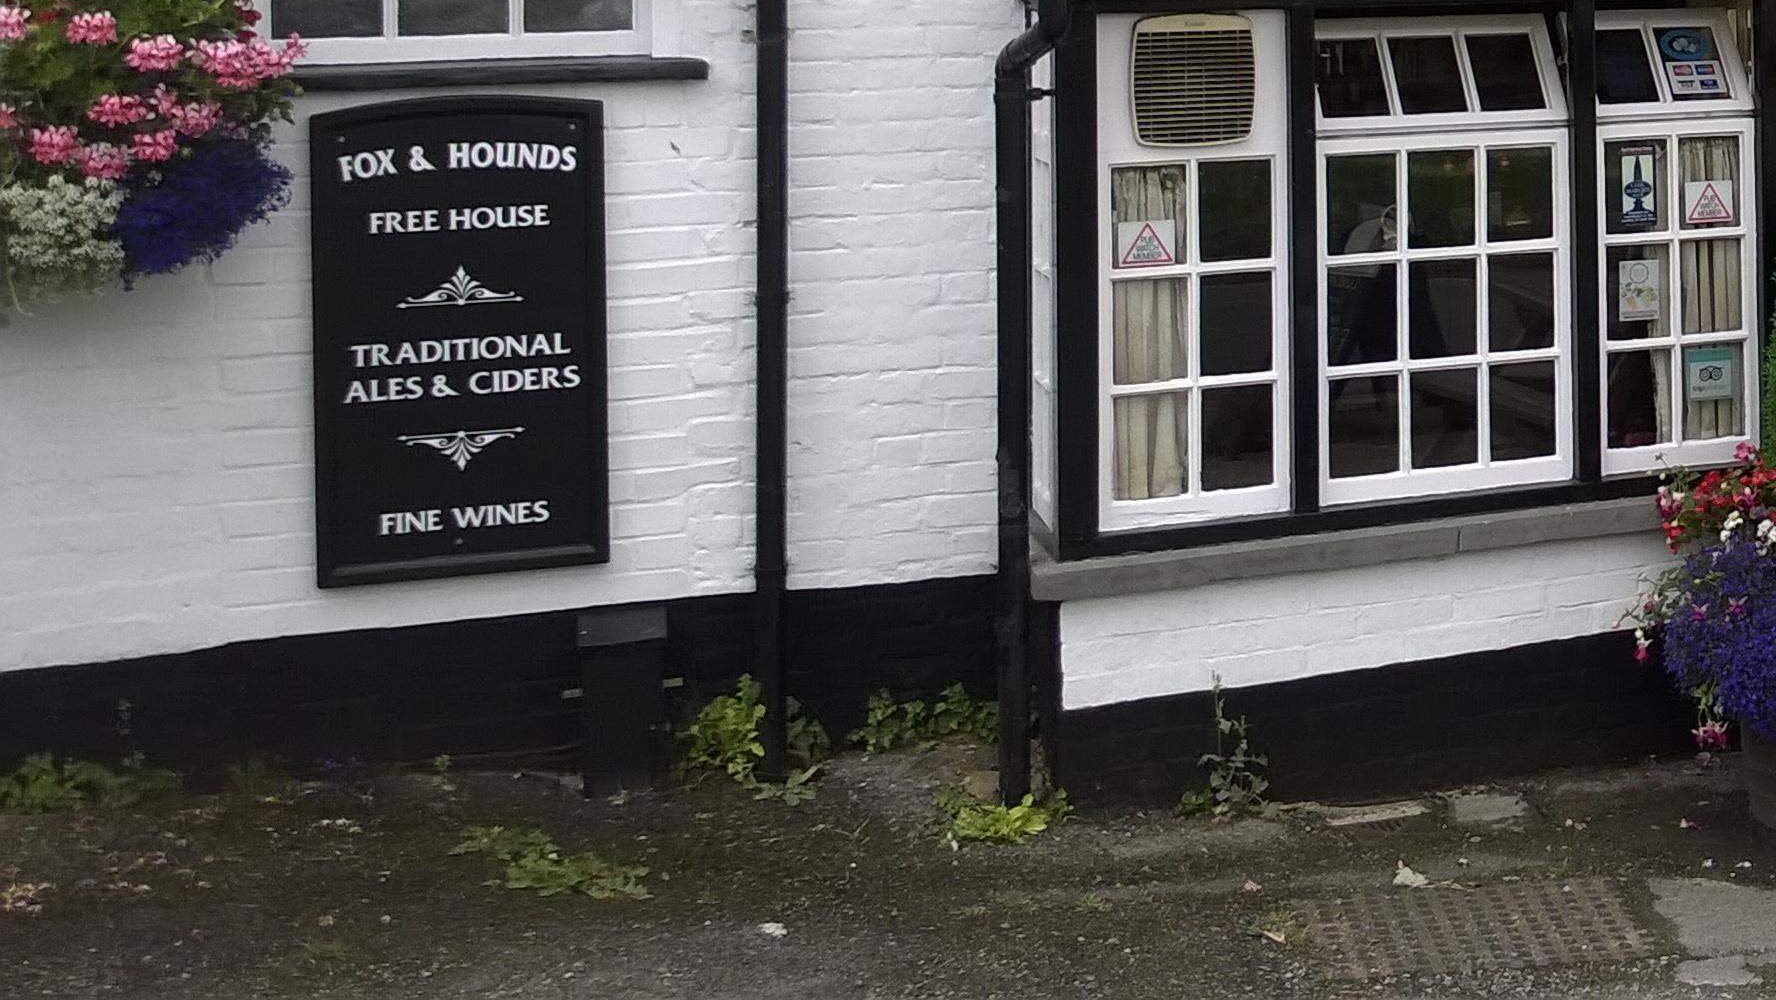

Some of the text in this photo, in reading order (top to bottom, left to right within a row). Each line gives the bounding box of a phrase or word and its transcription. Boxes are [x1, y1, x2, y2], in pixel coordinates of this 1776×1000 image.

[337, 142, 577, 182] FOX & HOUNDS
[368, 204, 550, 235] FREE HOUSE
[349, 332, 572, 368] TRADITIONAL
[342, 365, 581, 405] ALES & CIDERS
[379, 500, 550, 536] FINE WINES
